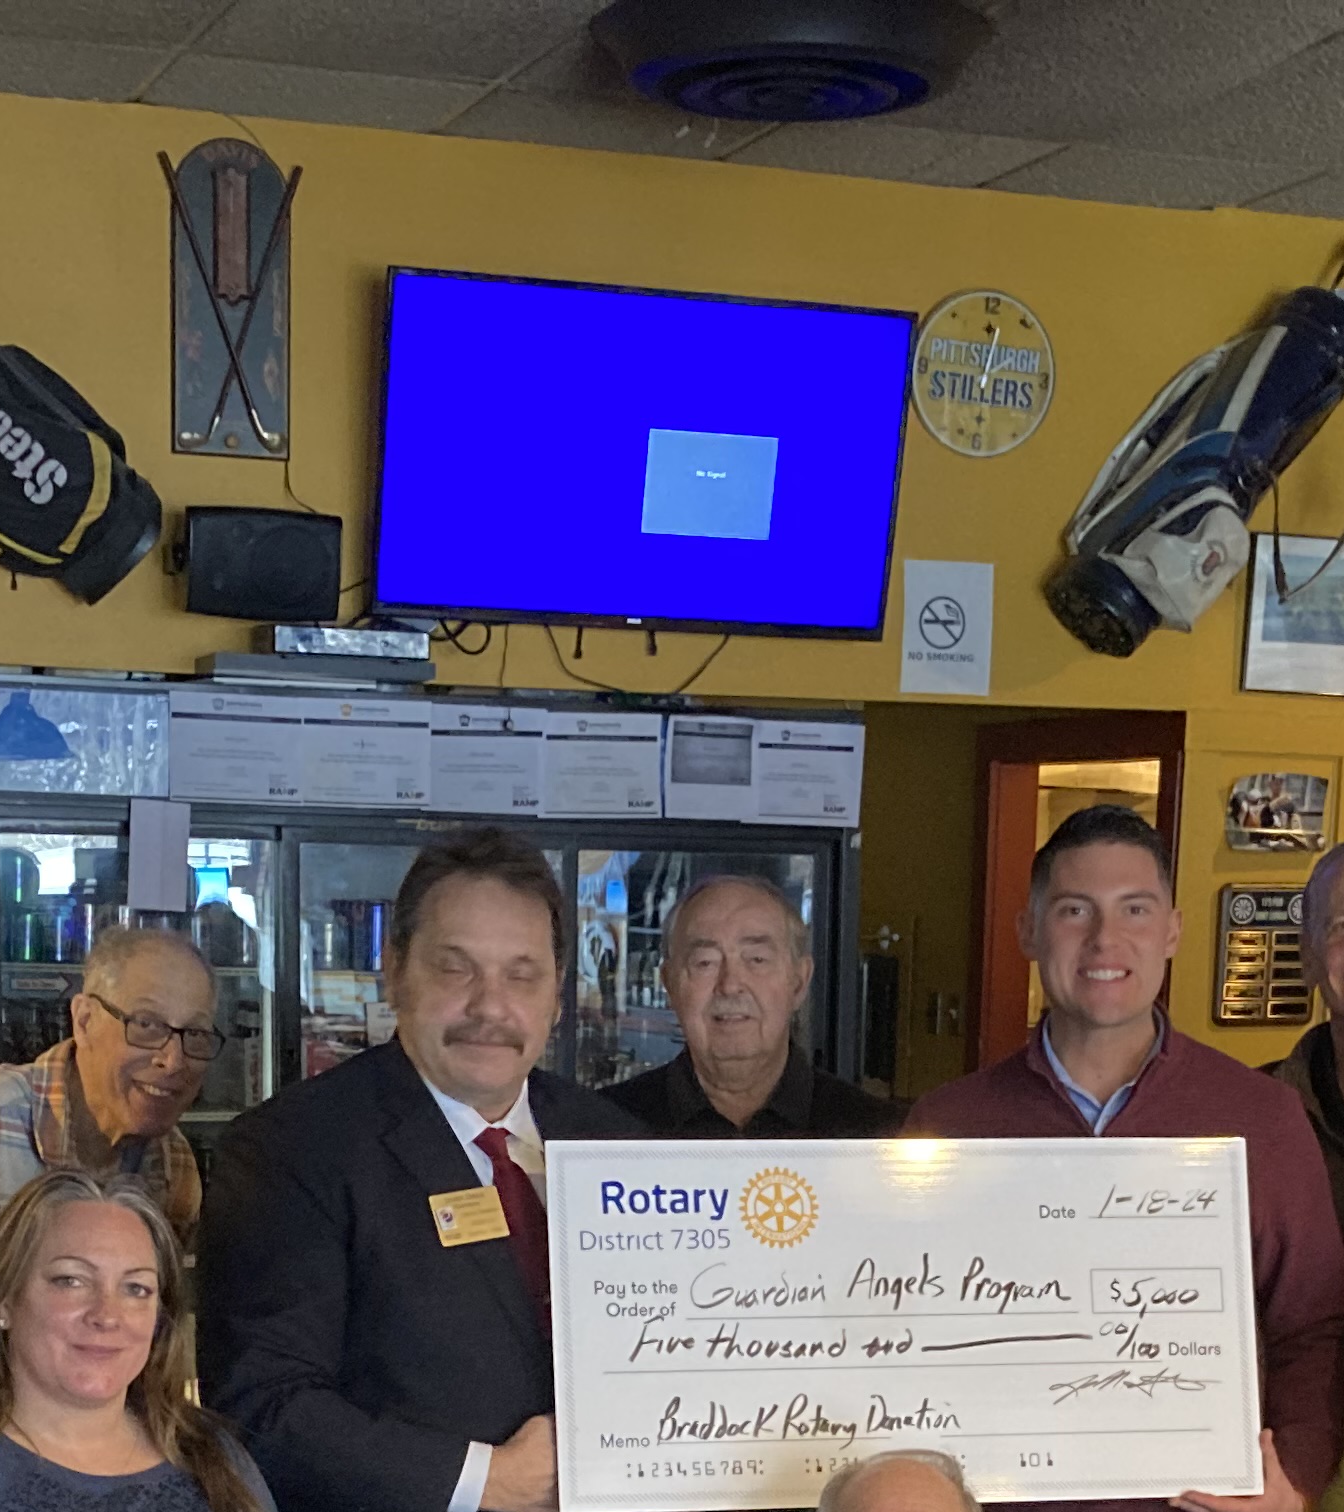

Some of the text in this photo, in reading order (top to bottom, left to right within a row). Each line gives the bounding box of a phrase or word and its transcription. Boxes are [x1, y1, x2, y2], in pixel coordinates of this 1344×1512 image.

[930, 337, 1041, 374] PITTSBURGH
[930, 370, 1034, 411] STILLERS
[907, 651, 975, 663] NO SMOKING
[600, 1180, 729, 1221] Rotary
[1039, 1205, 1076, 1219] Date
[579, 1228, 731, 1251] District 7305
[593, 1279, 678, 1298] Pay to the
[690, 1252, 1072, 1315] Guardian Angels Program
[606, 1301, 676, 1317] Order of
[629, 1315, 696, 1363] Five
[706, 1321, 847, 1360] thousand
[1168, 1340, 1222, 1357] Dollars
[866, 1395, 962, 1432] Donation
[600, 1434, 650, 1449] Memo
